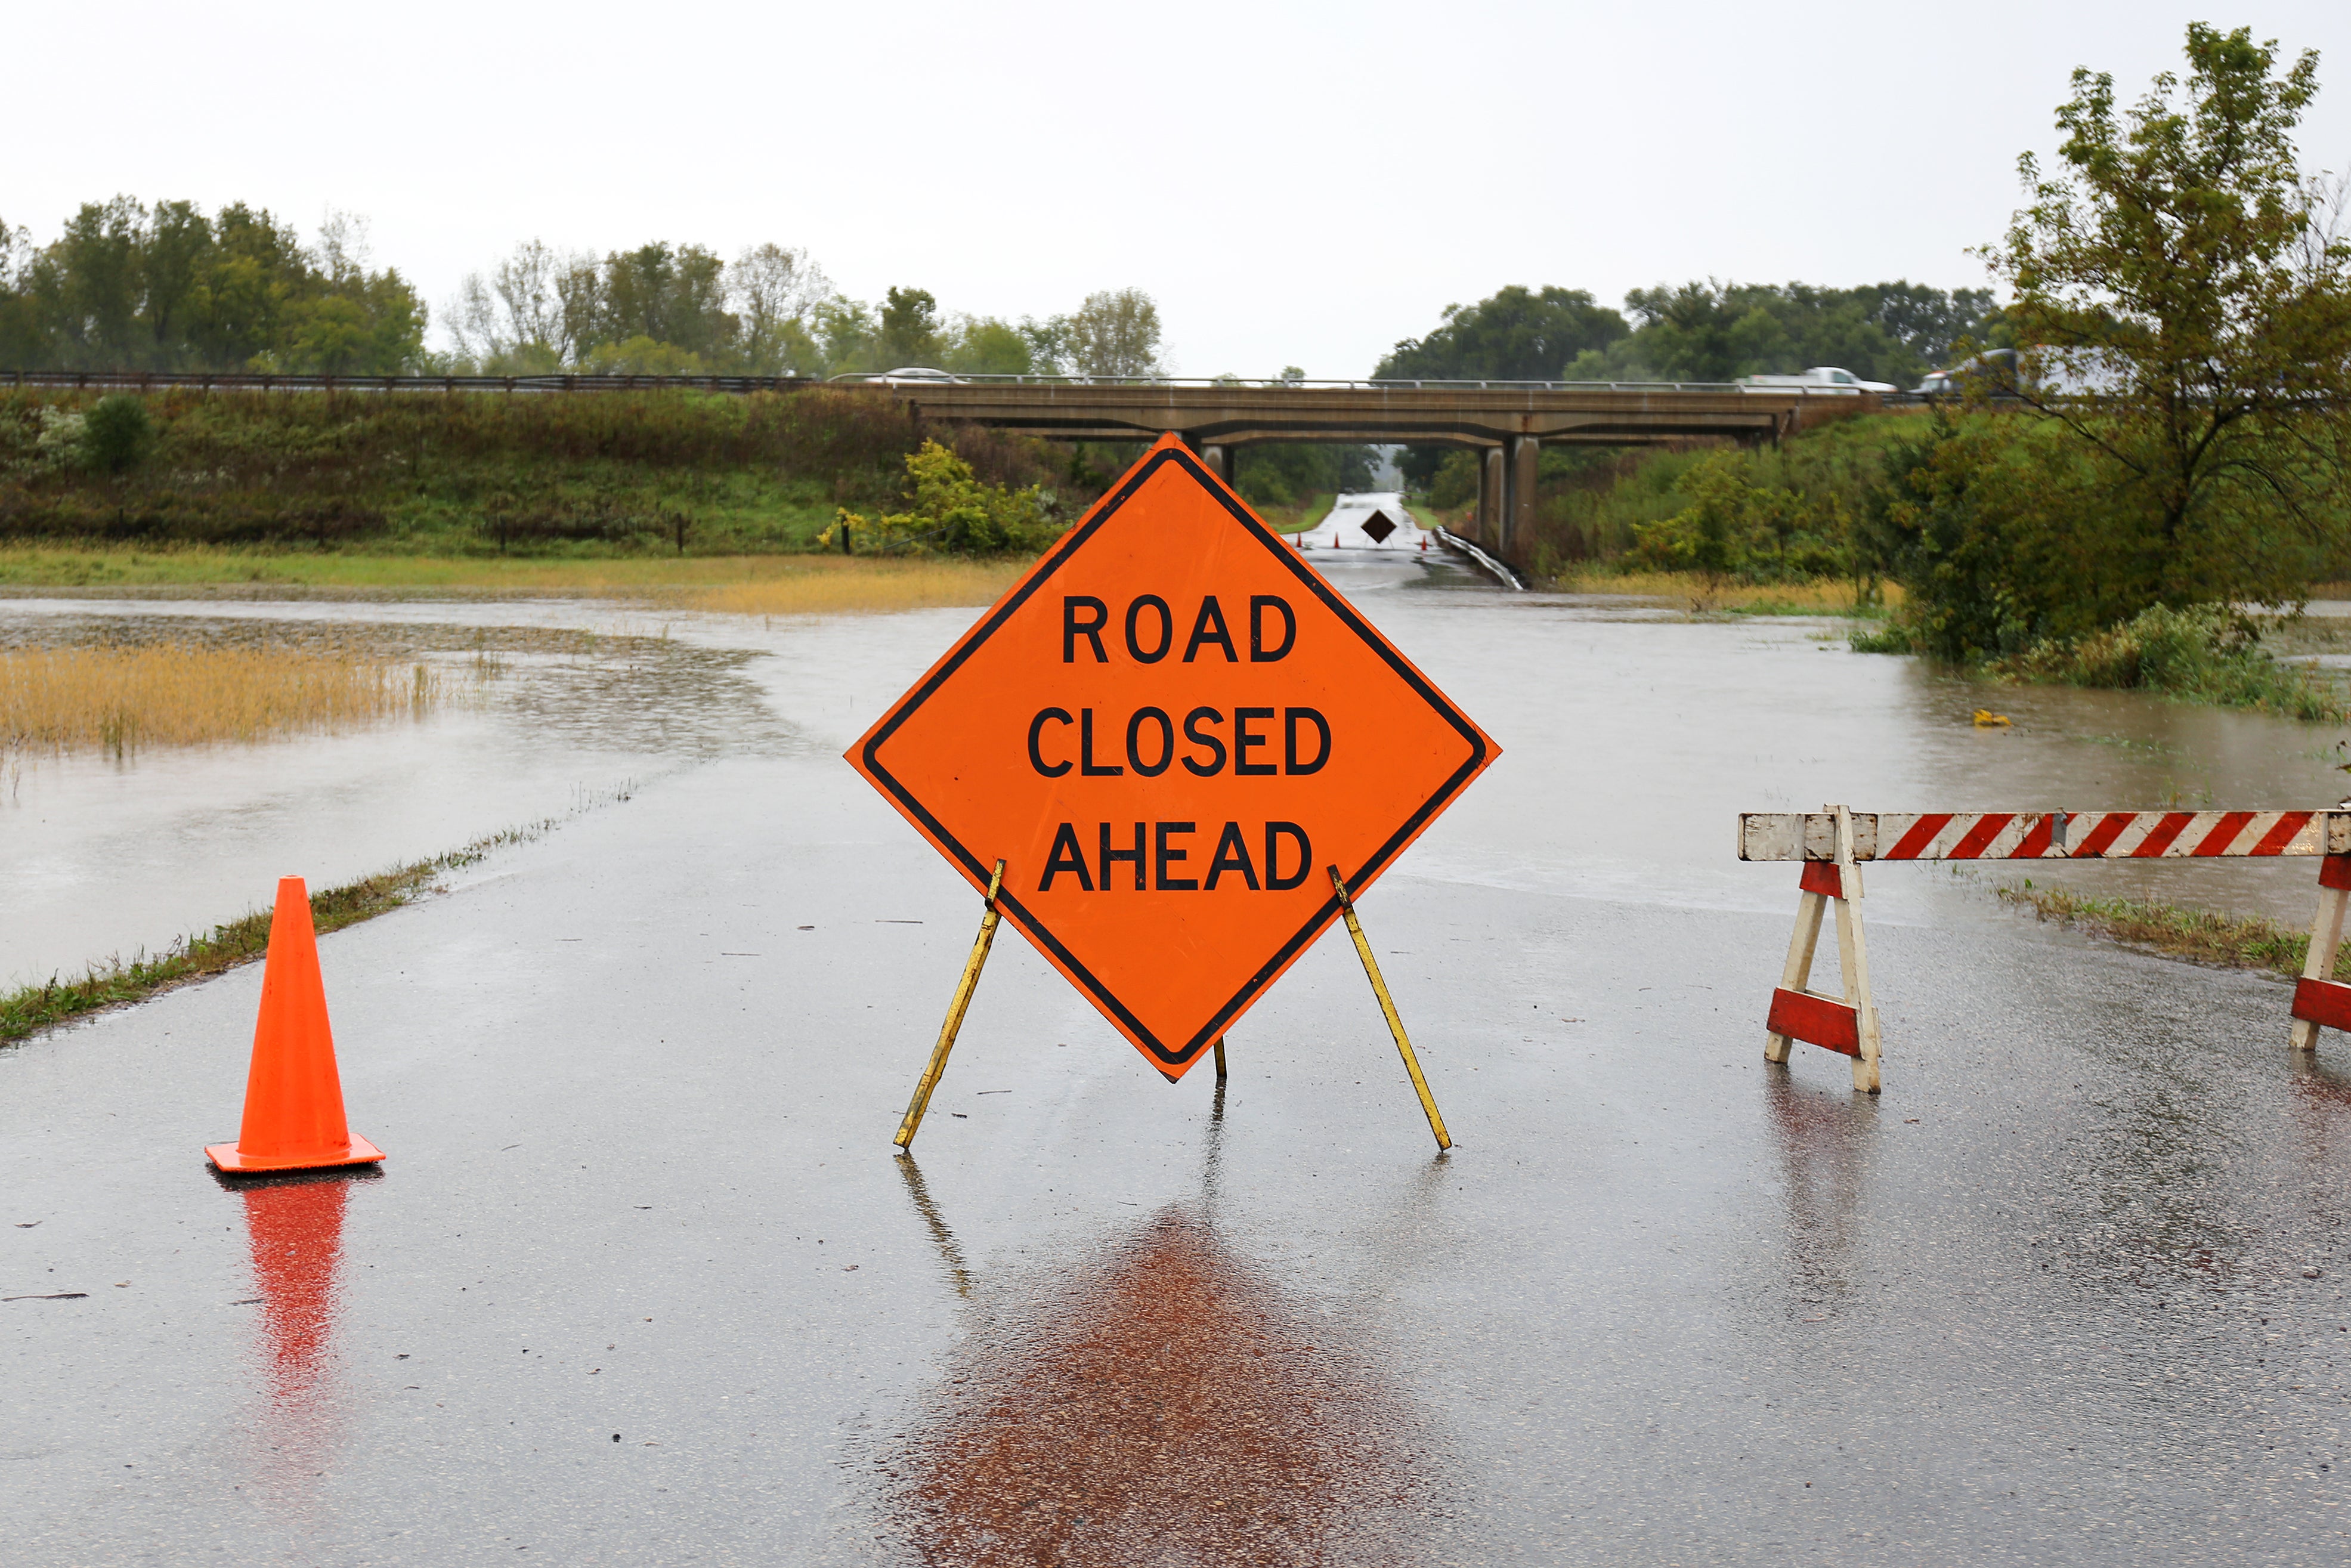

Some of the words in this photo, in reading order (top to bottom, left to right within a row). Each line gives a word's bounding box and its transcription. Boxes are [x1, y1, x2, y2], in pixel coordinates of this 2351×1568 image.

[1063, 594, 1297, 664] ROAD
[1028, 706, 1331, 778] CLOSED
[1038, 821, 1312, 892] AHEAD
